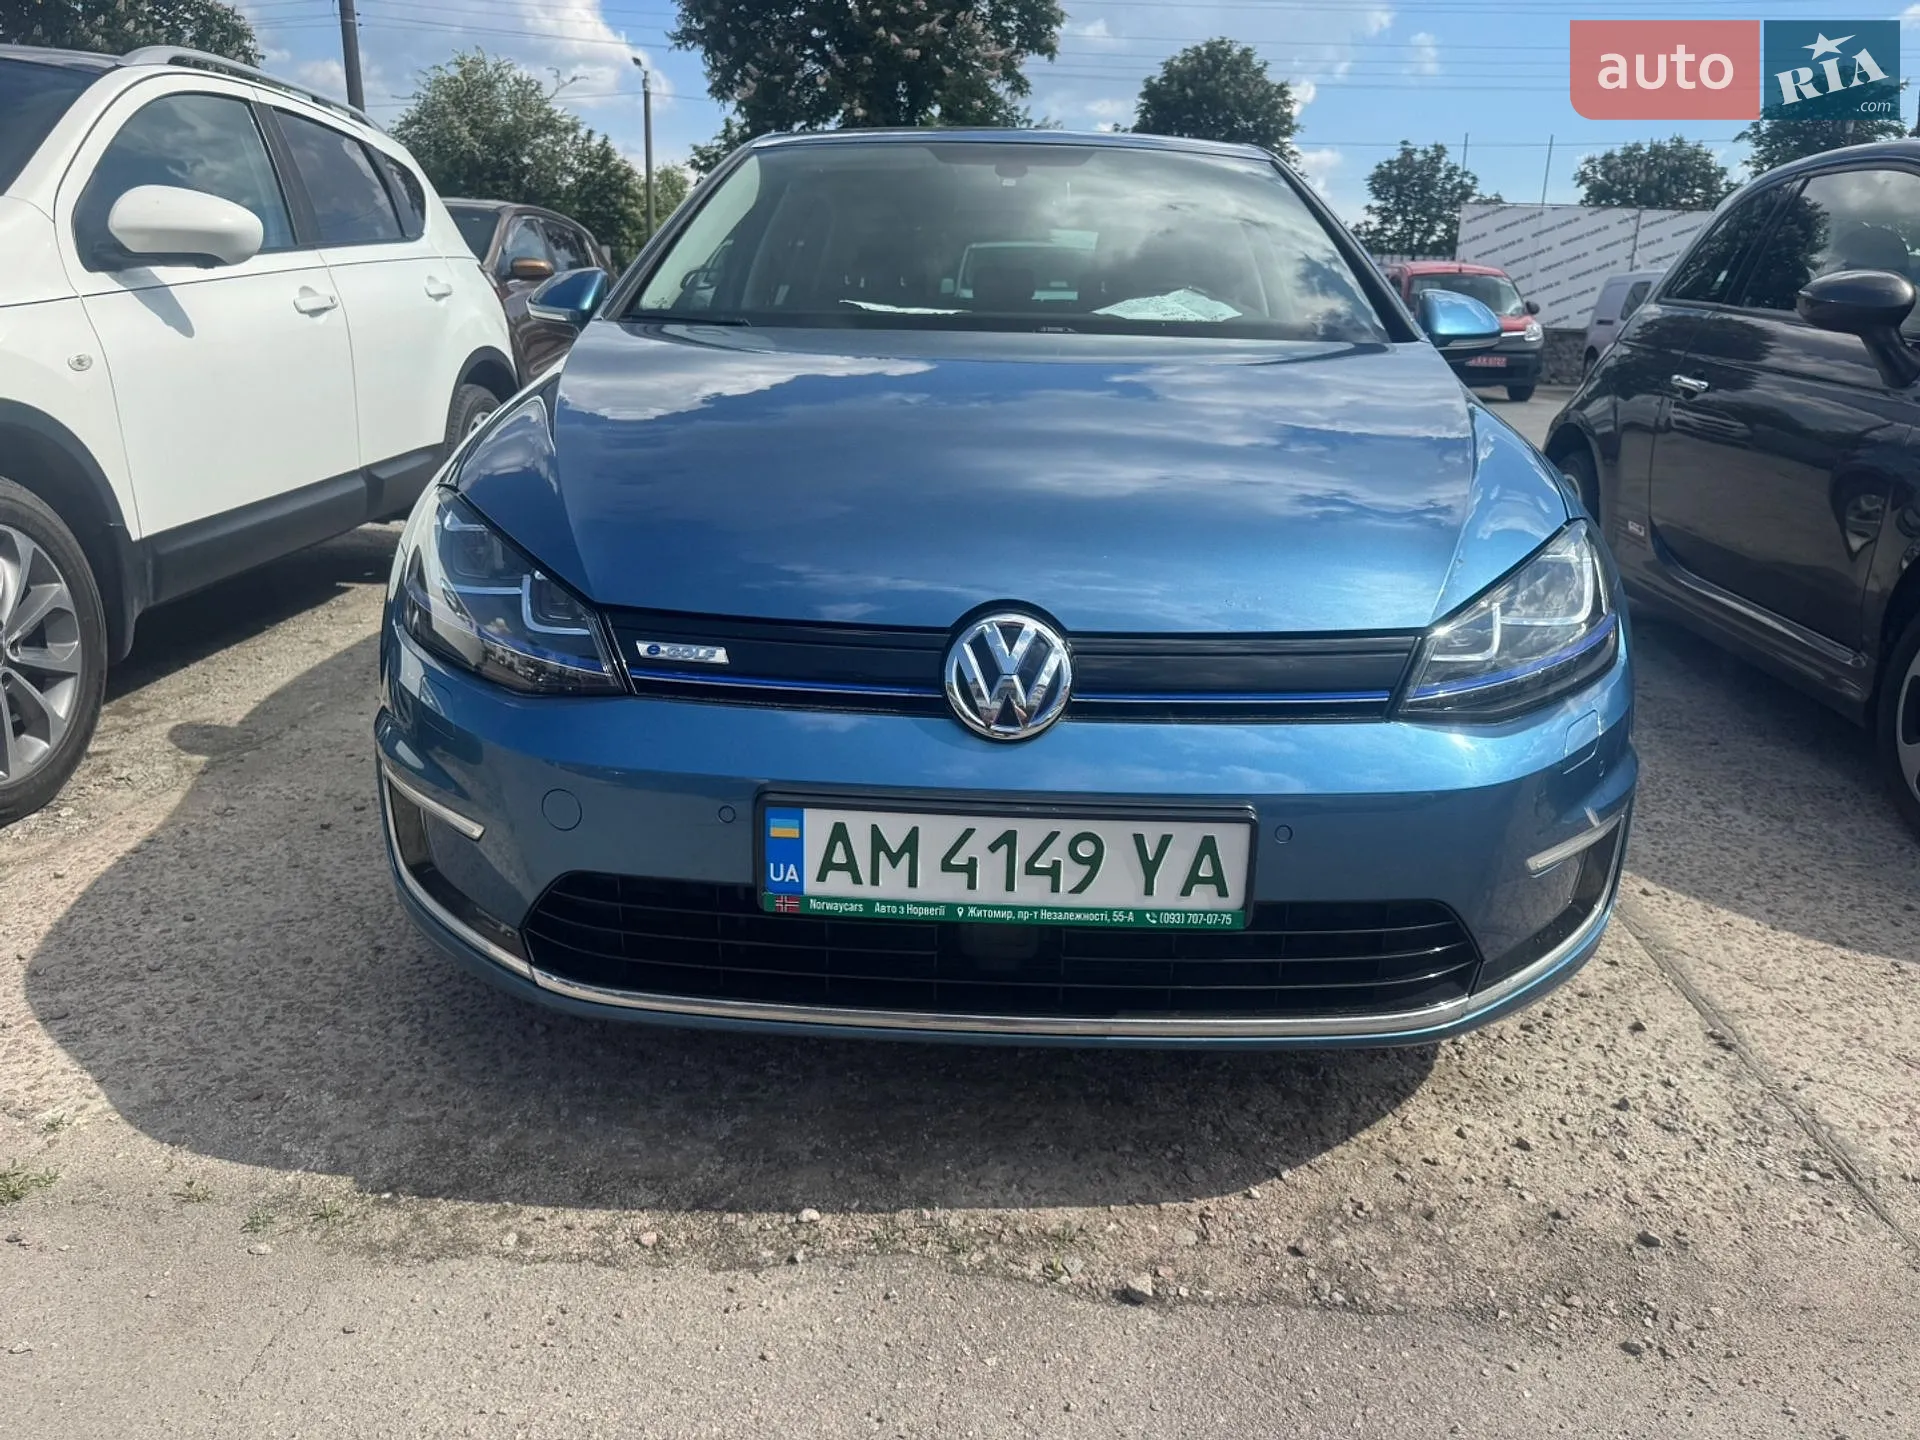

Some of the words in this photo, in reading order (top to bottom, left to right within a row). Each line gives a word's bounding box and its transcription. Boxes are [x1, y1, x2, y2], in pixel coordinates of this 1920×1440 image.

[816, 820, 920, 888] AM
[940, 827, 1107, 894] 4149
[1132, 832, 1230, 898] YA
[770, 863, 799, 882] UA
[810, 898, 864, 912] Norwaycars
[874, 902, 897, 914] Авто
[899, 906, 905, 914] з
[906, 903, 946, 916] Норвегії
[967, 906, 1016, 920] Житомир,
[1018, 910, 1038, 921] пр-т
[1041, 909, 1110, 923] Незалежності,
[1112, 911, 1134, 922] 55-А
[1160, 912, 1185, 924] (093)
